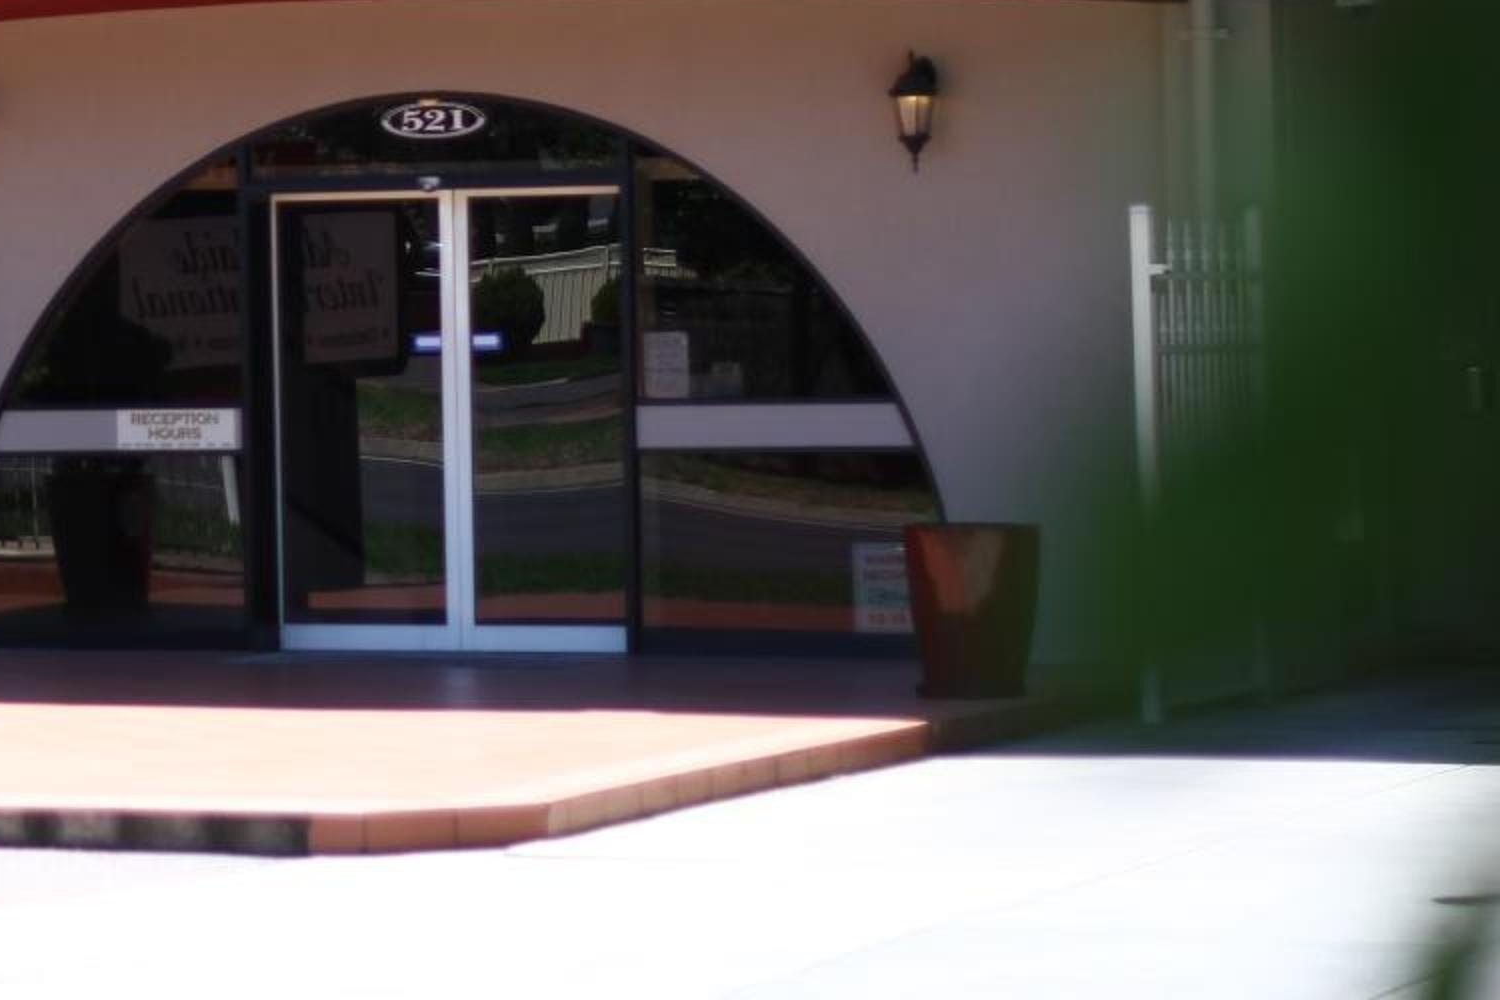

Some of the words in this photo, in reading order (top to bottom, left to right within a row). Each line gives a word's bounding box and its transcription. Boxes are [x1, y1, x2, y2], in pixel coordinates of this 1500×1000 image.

[401, 109, 464, 132] 521
[130, 409, 219, 424] RECEPTION
[147, 426, 202, 440] HOURS
